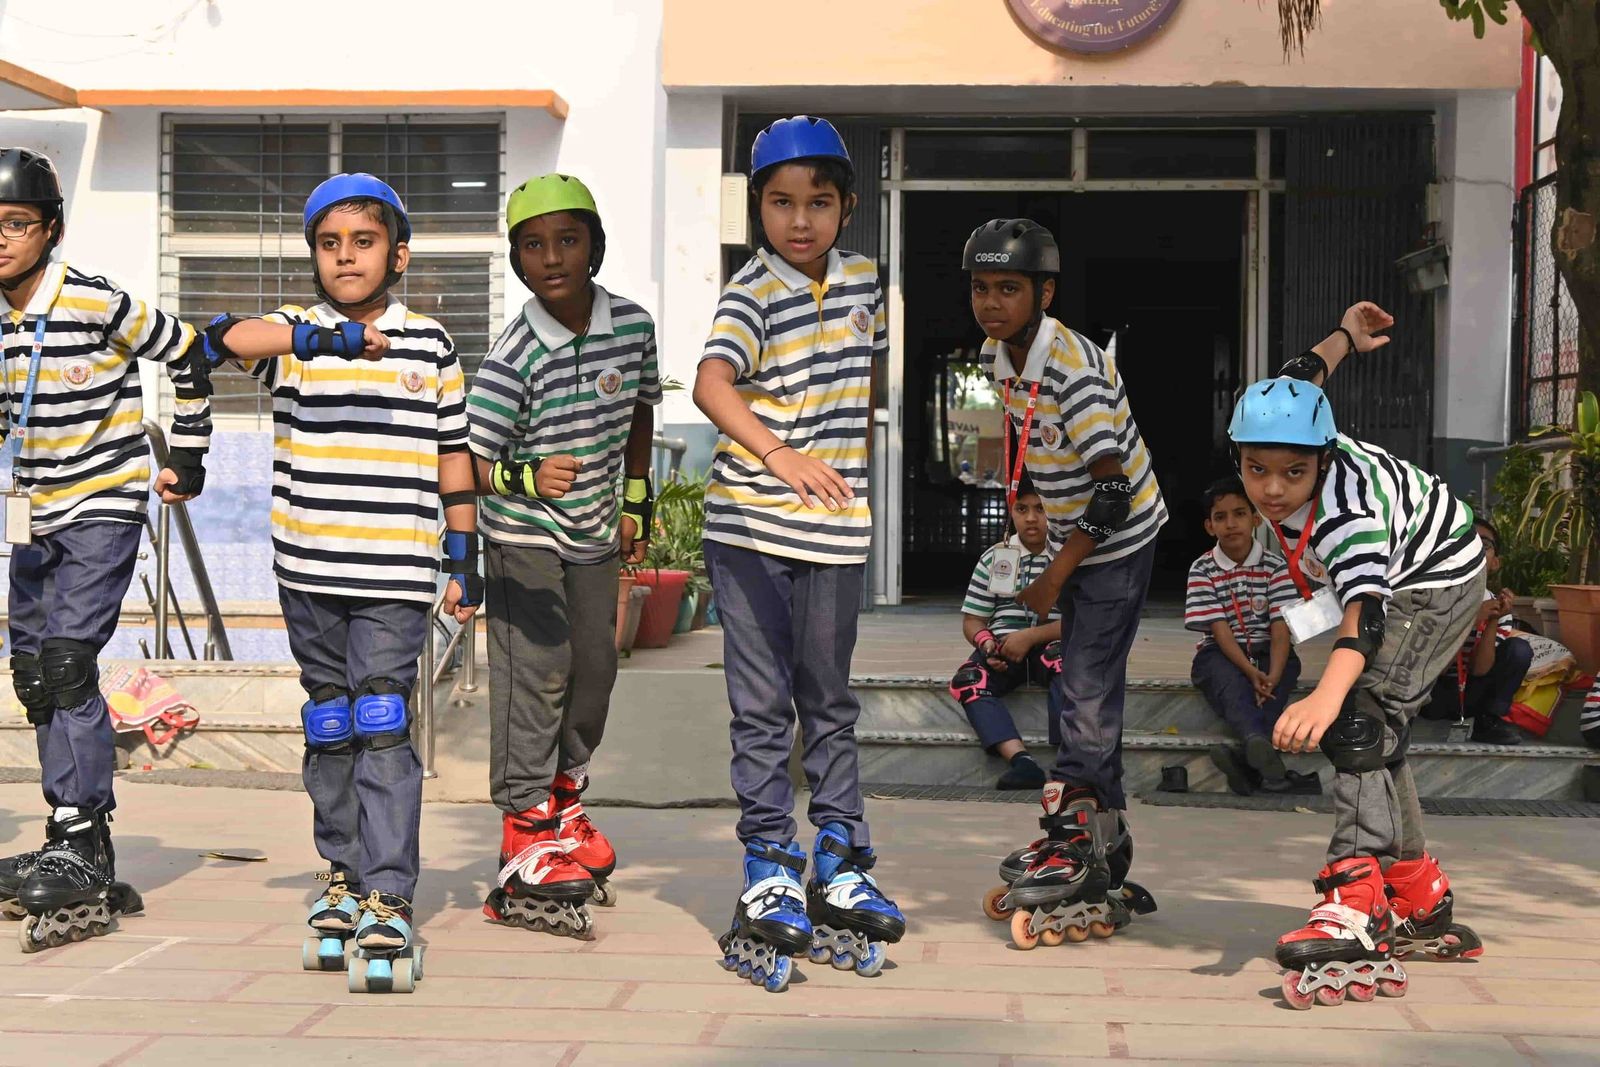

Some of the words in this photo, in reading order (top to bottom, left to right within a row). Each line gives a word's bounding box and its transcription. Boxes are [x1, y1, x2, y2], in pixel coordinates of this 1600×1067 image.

[1030, 0, 1090, 37] Educating
[1093, 23, 1114, 36] the
[975, 253, 1010, 263] COSCO
